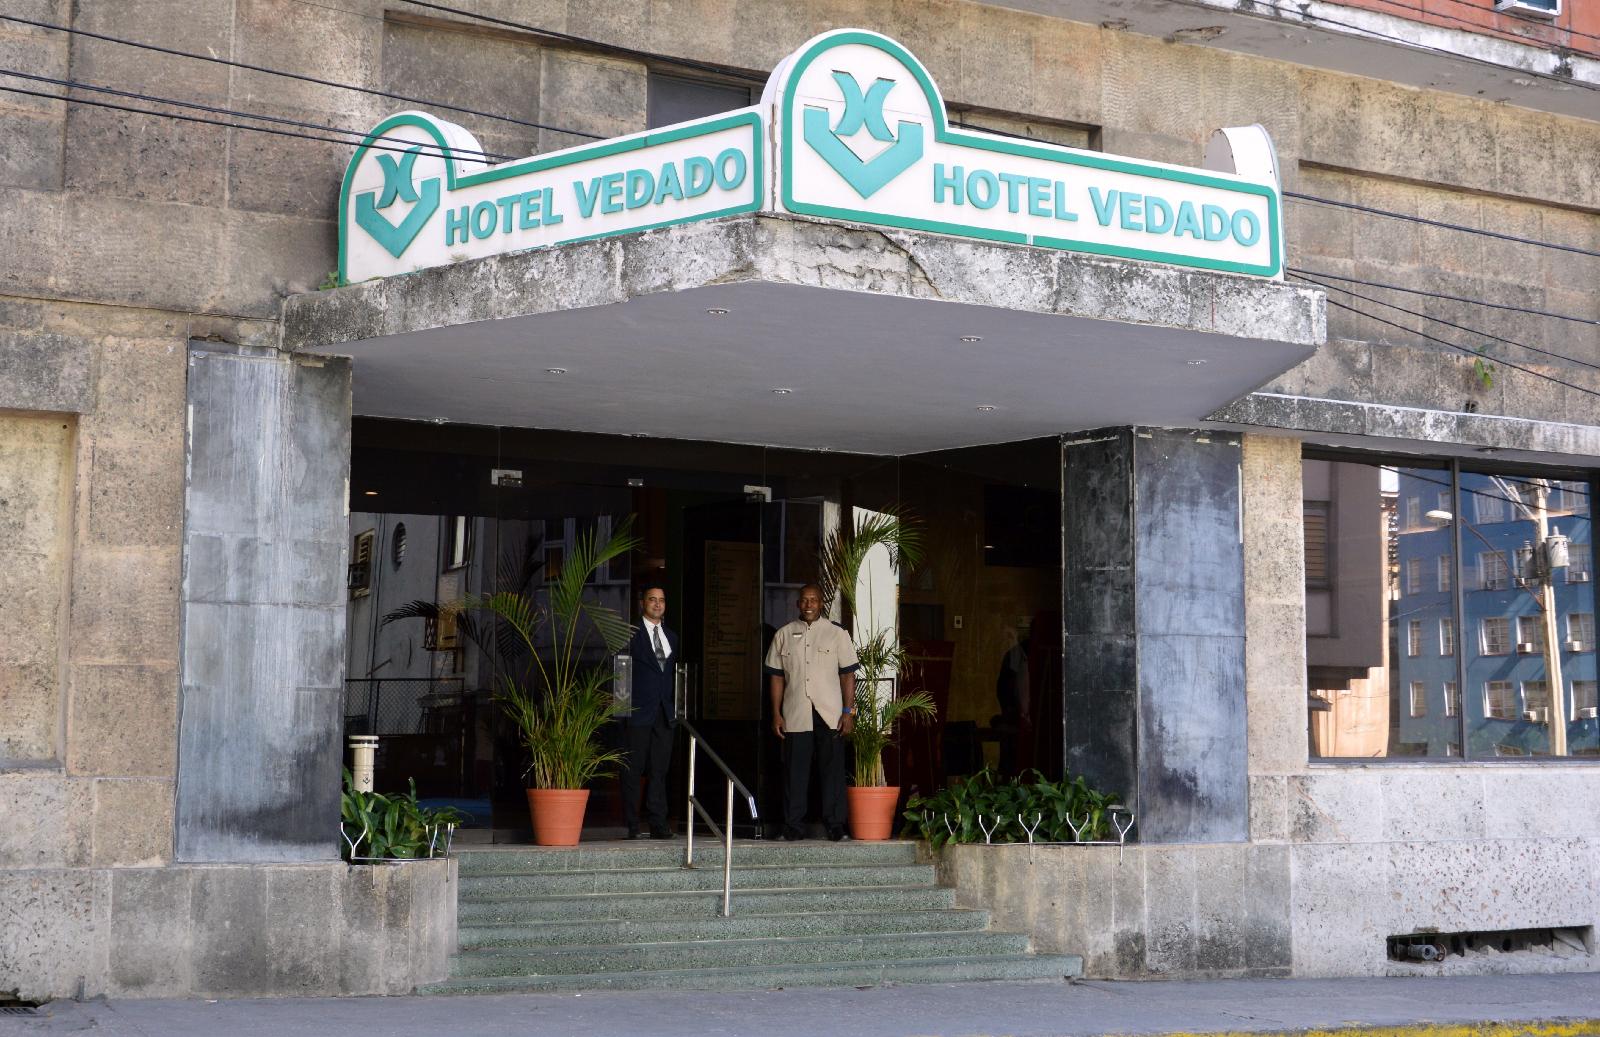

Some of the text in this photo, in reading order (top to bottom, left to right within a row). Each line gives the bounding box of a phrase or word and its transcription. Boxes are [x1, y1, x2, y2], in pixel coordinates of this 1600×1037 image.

[446, 149, 747, 246] HOTEL VEDADO
[933, 163, 1260, 247] HOTEL VEDADO
